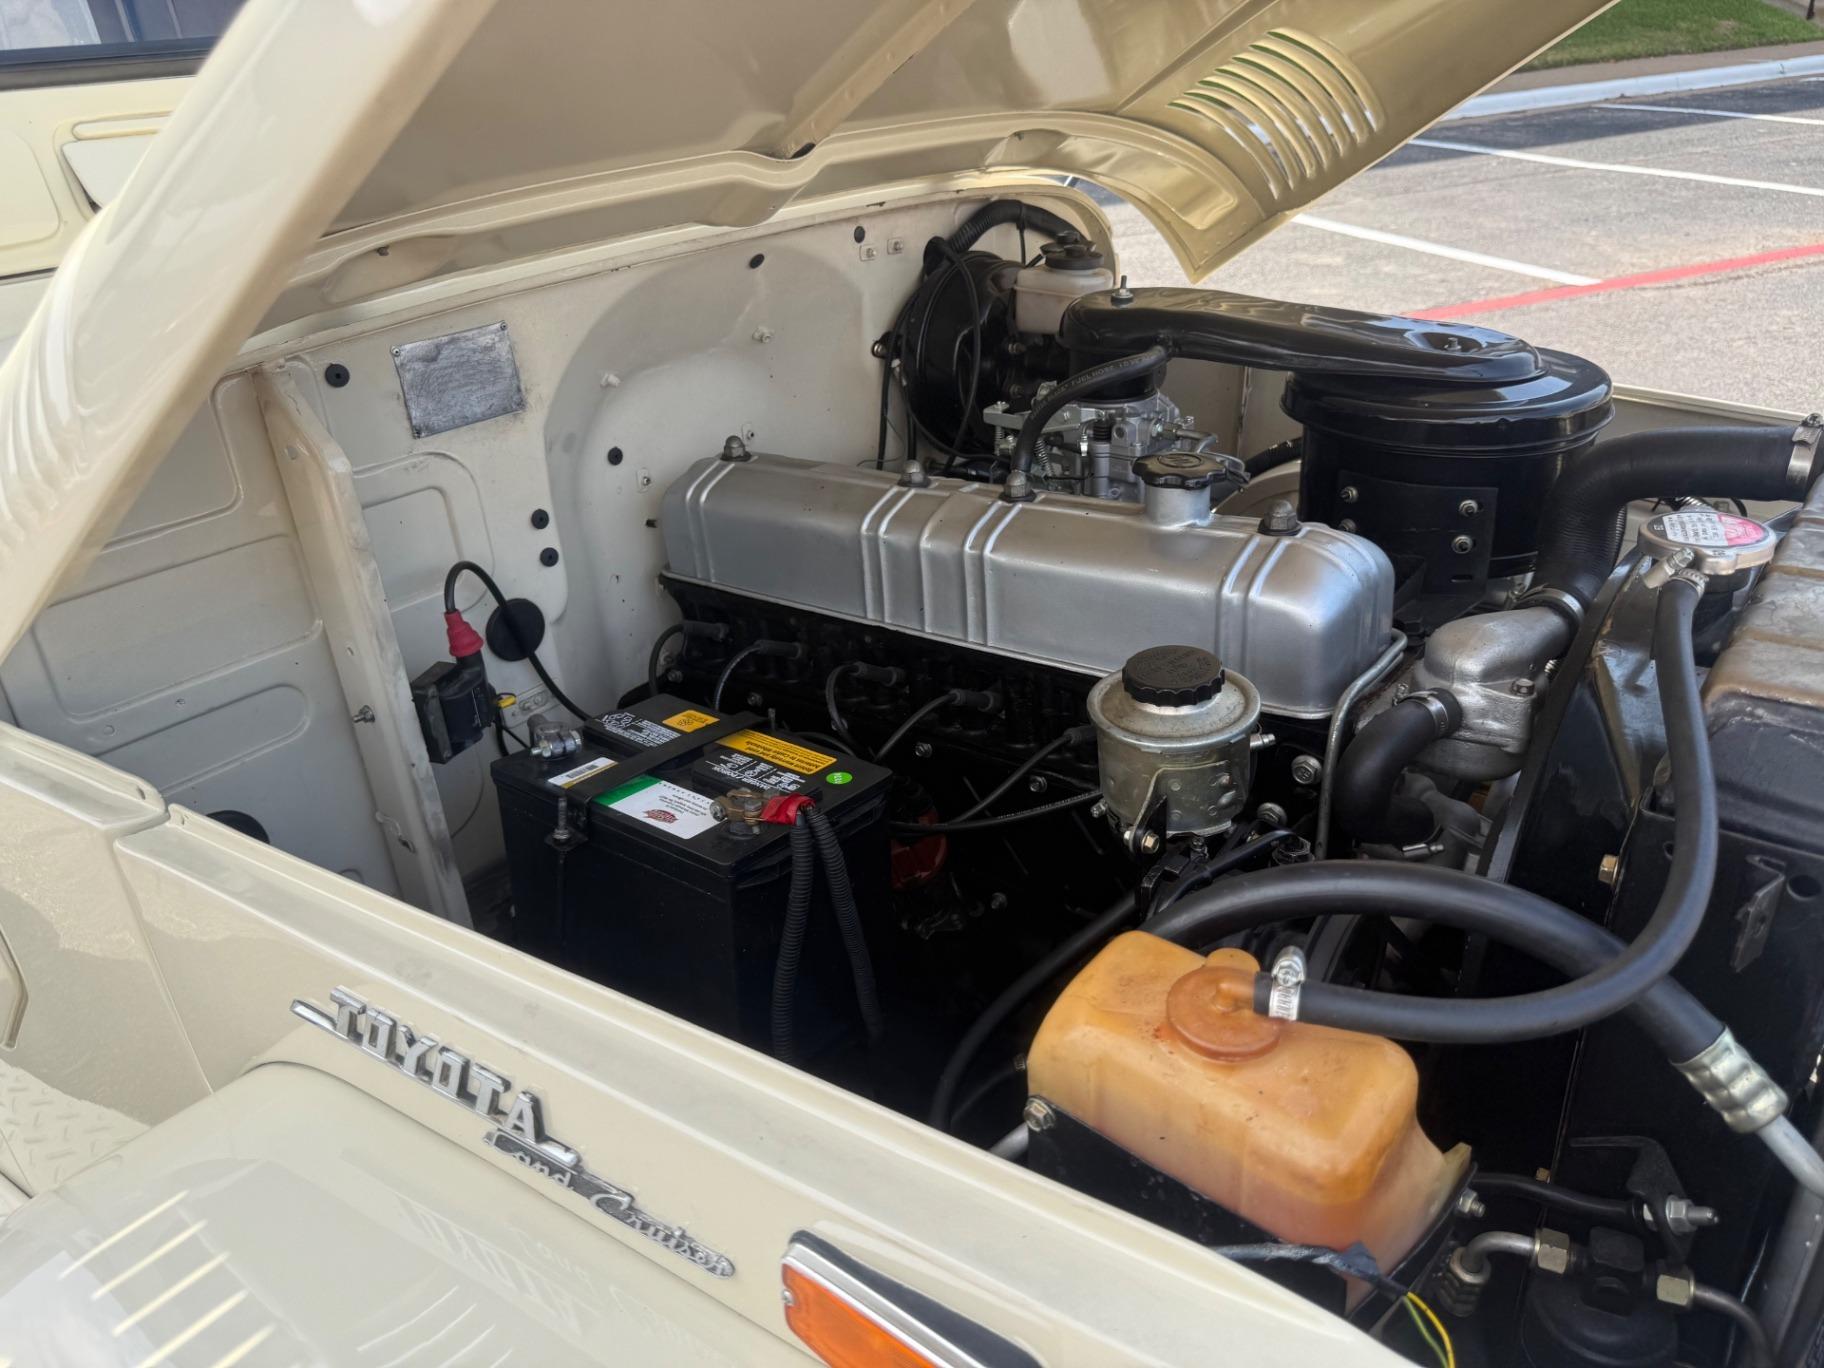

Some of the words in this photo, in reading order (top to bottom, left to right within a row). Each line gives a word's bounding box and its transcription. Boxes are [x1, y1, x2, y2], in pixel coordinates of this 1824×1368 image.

[330, 985, 545, 1144] TOYOTA
[482, 1127, 575, 1191] Land
[590, 1192, 735, 1279] Cruiser
